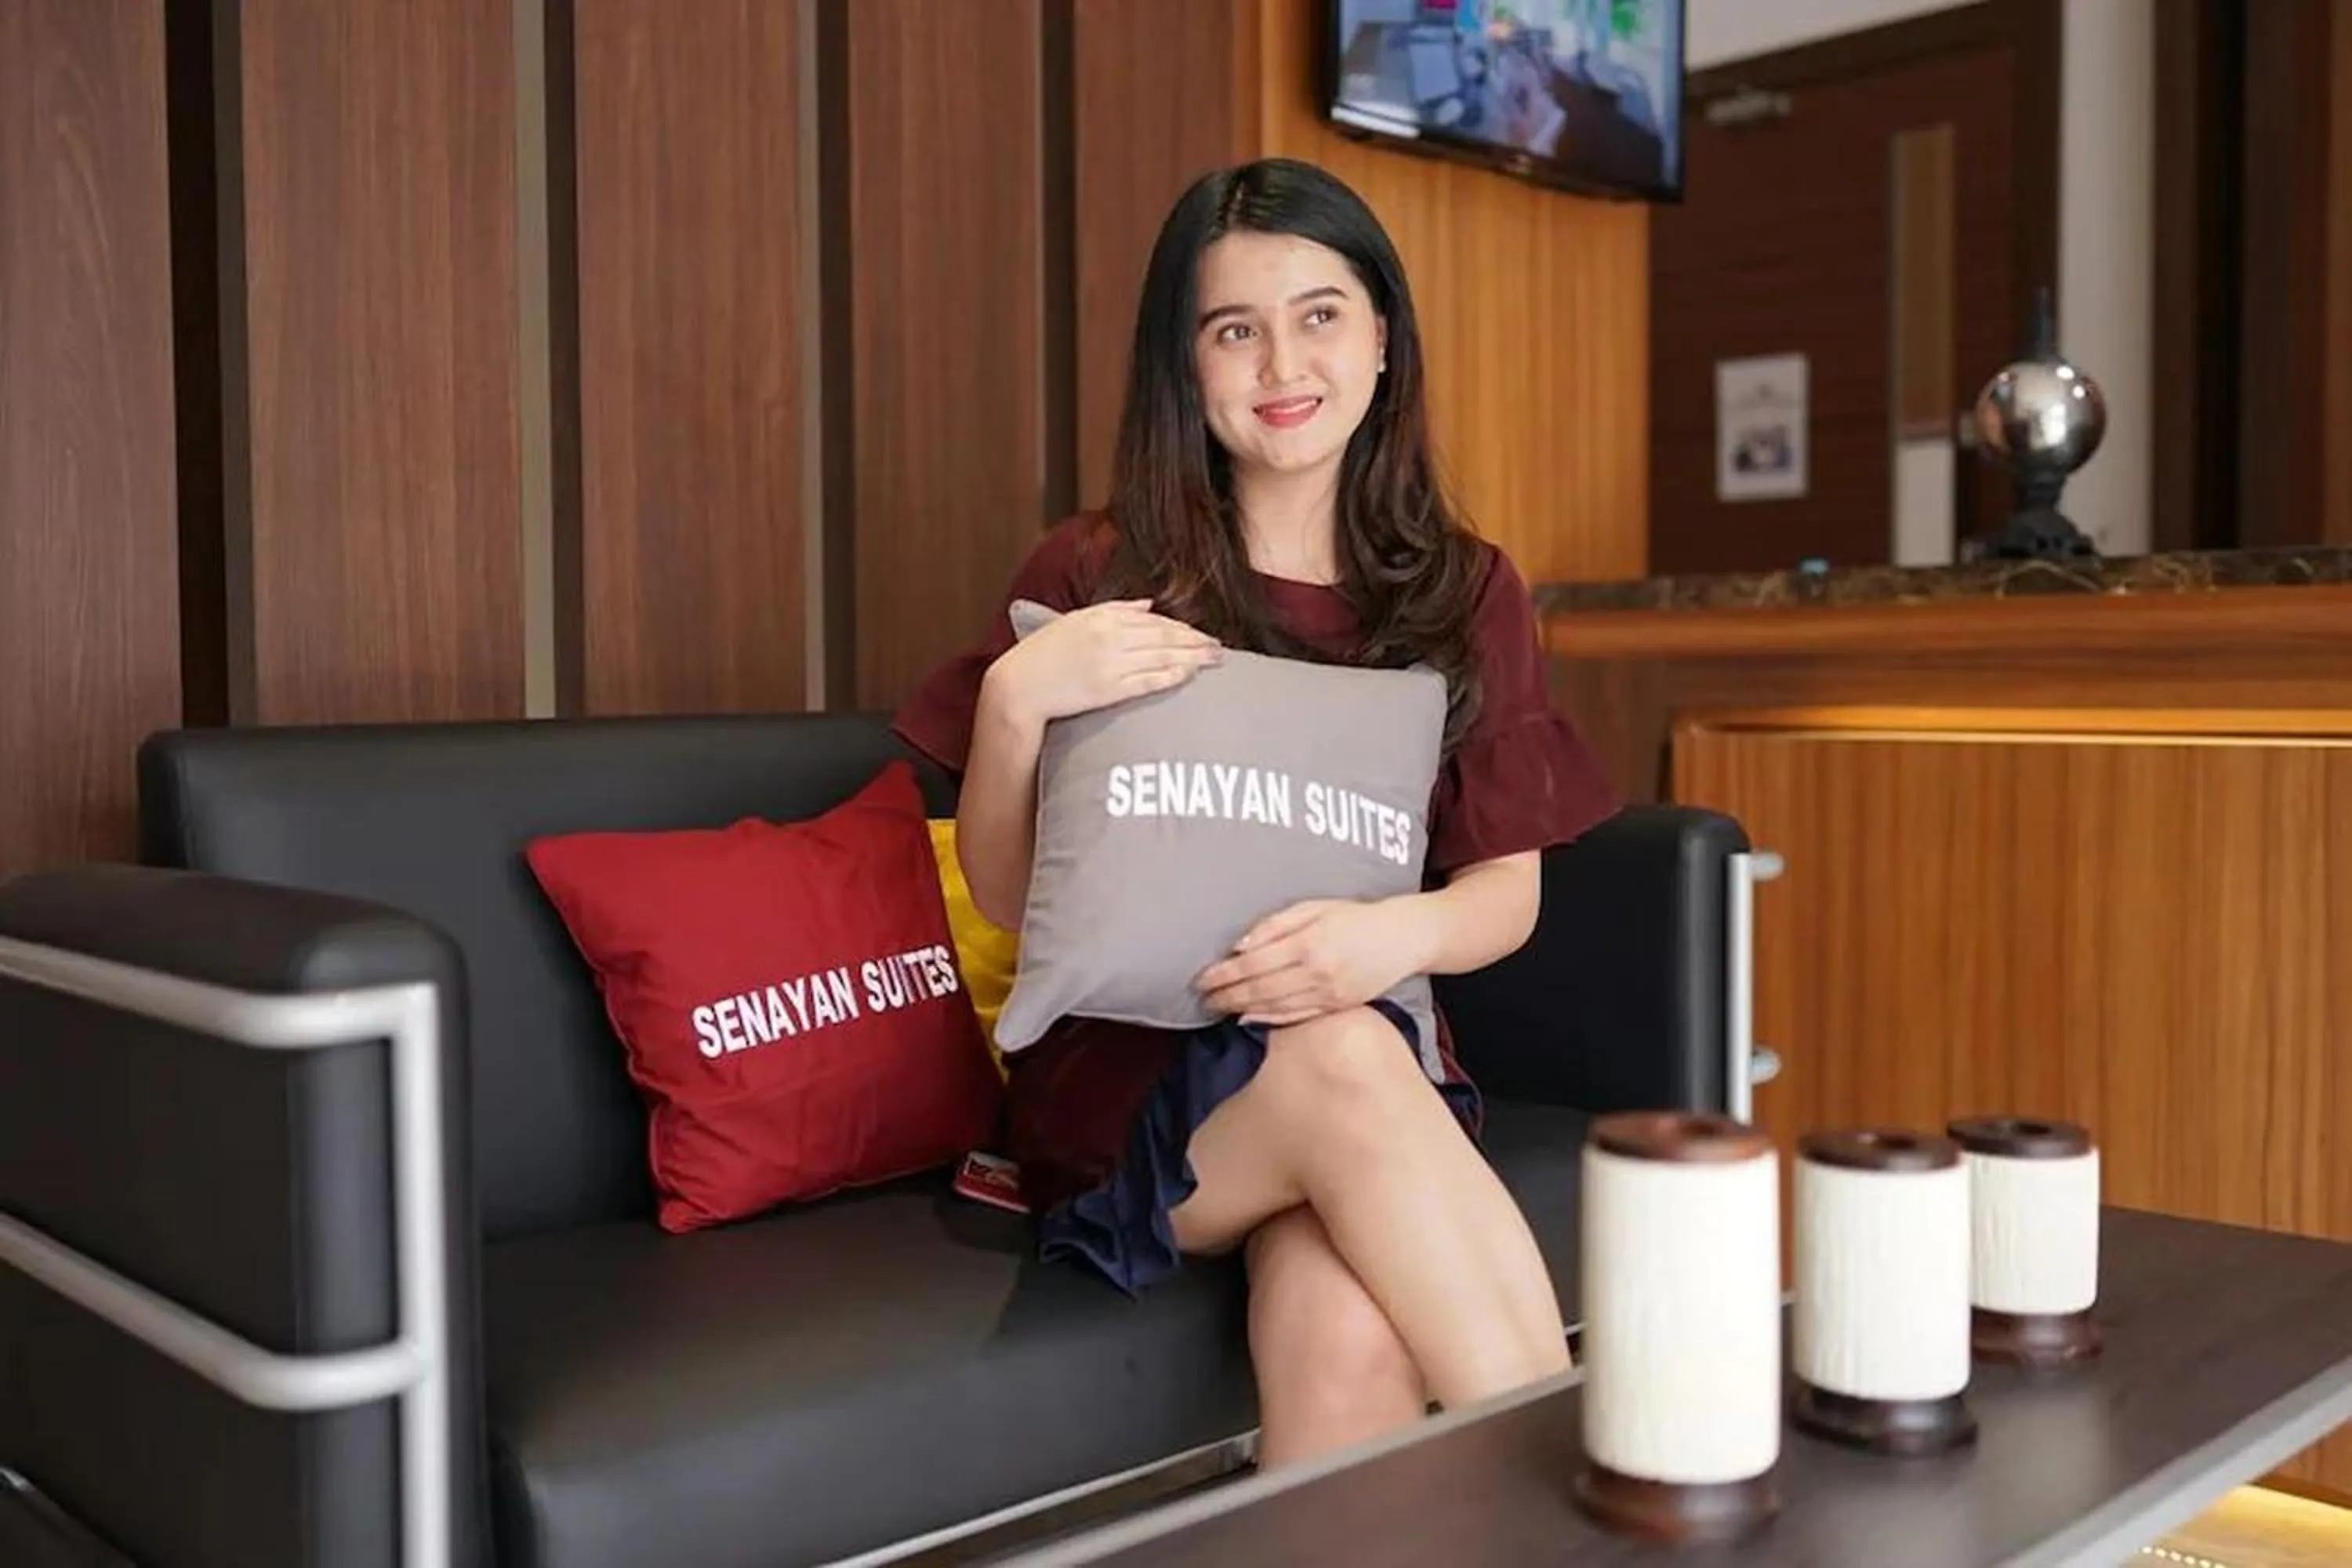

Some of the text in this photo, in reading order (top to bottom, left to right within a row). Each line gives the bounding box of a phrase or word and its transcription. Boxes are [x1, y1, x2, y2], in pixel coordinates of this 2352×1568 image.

[1106, 760, 1412, 866] SENAYAN SUITES
[692, 945, 959, 1058] SENAYAN SUITES
